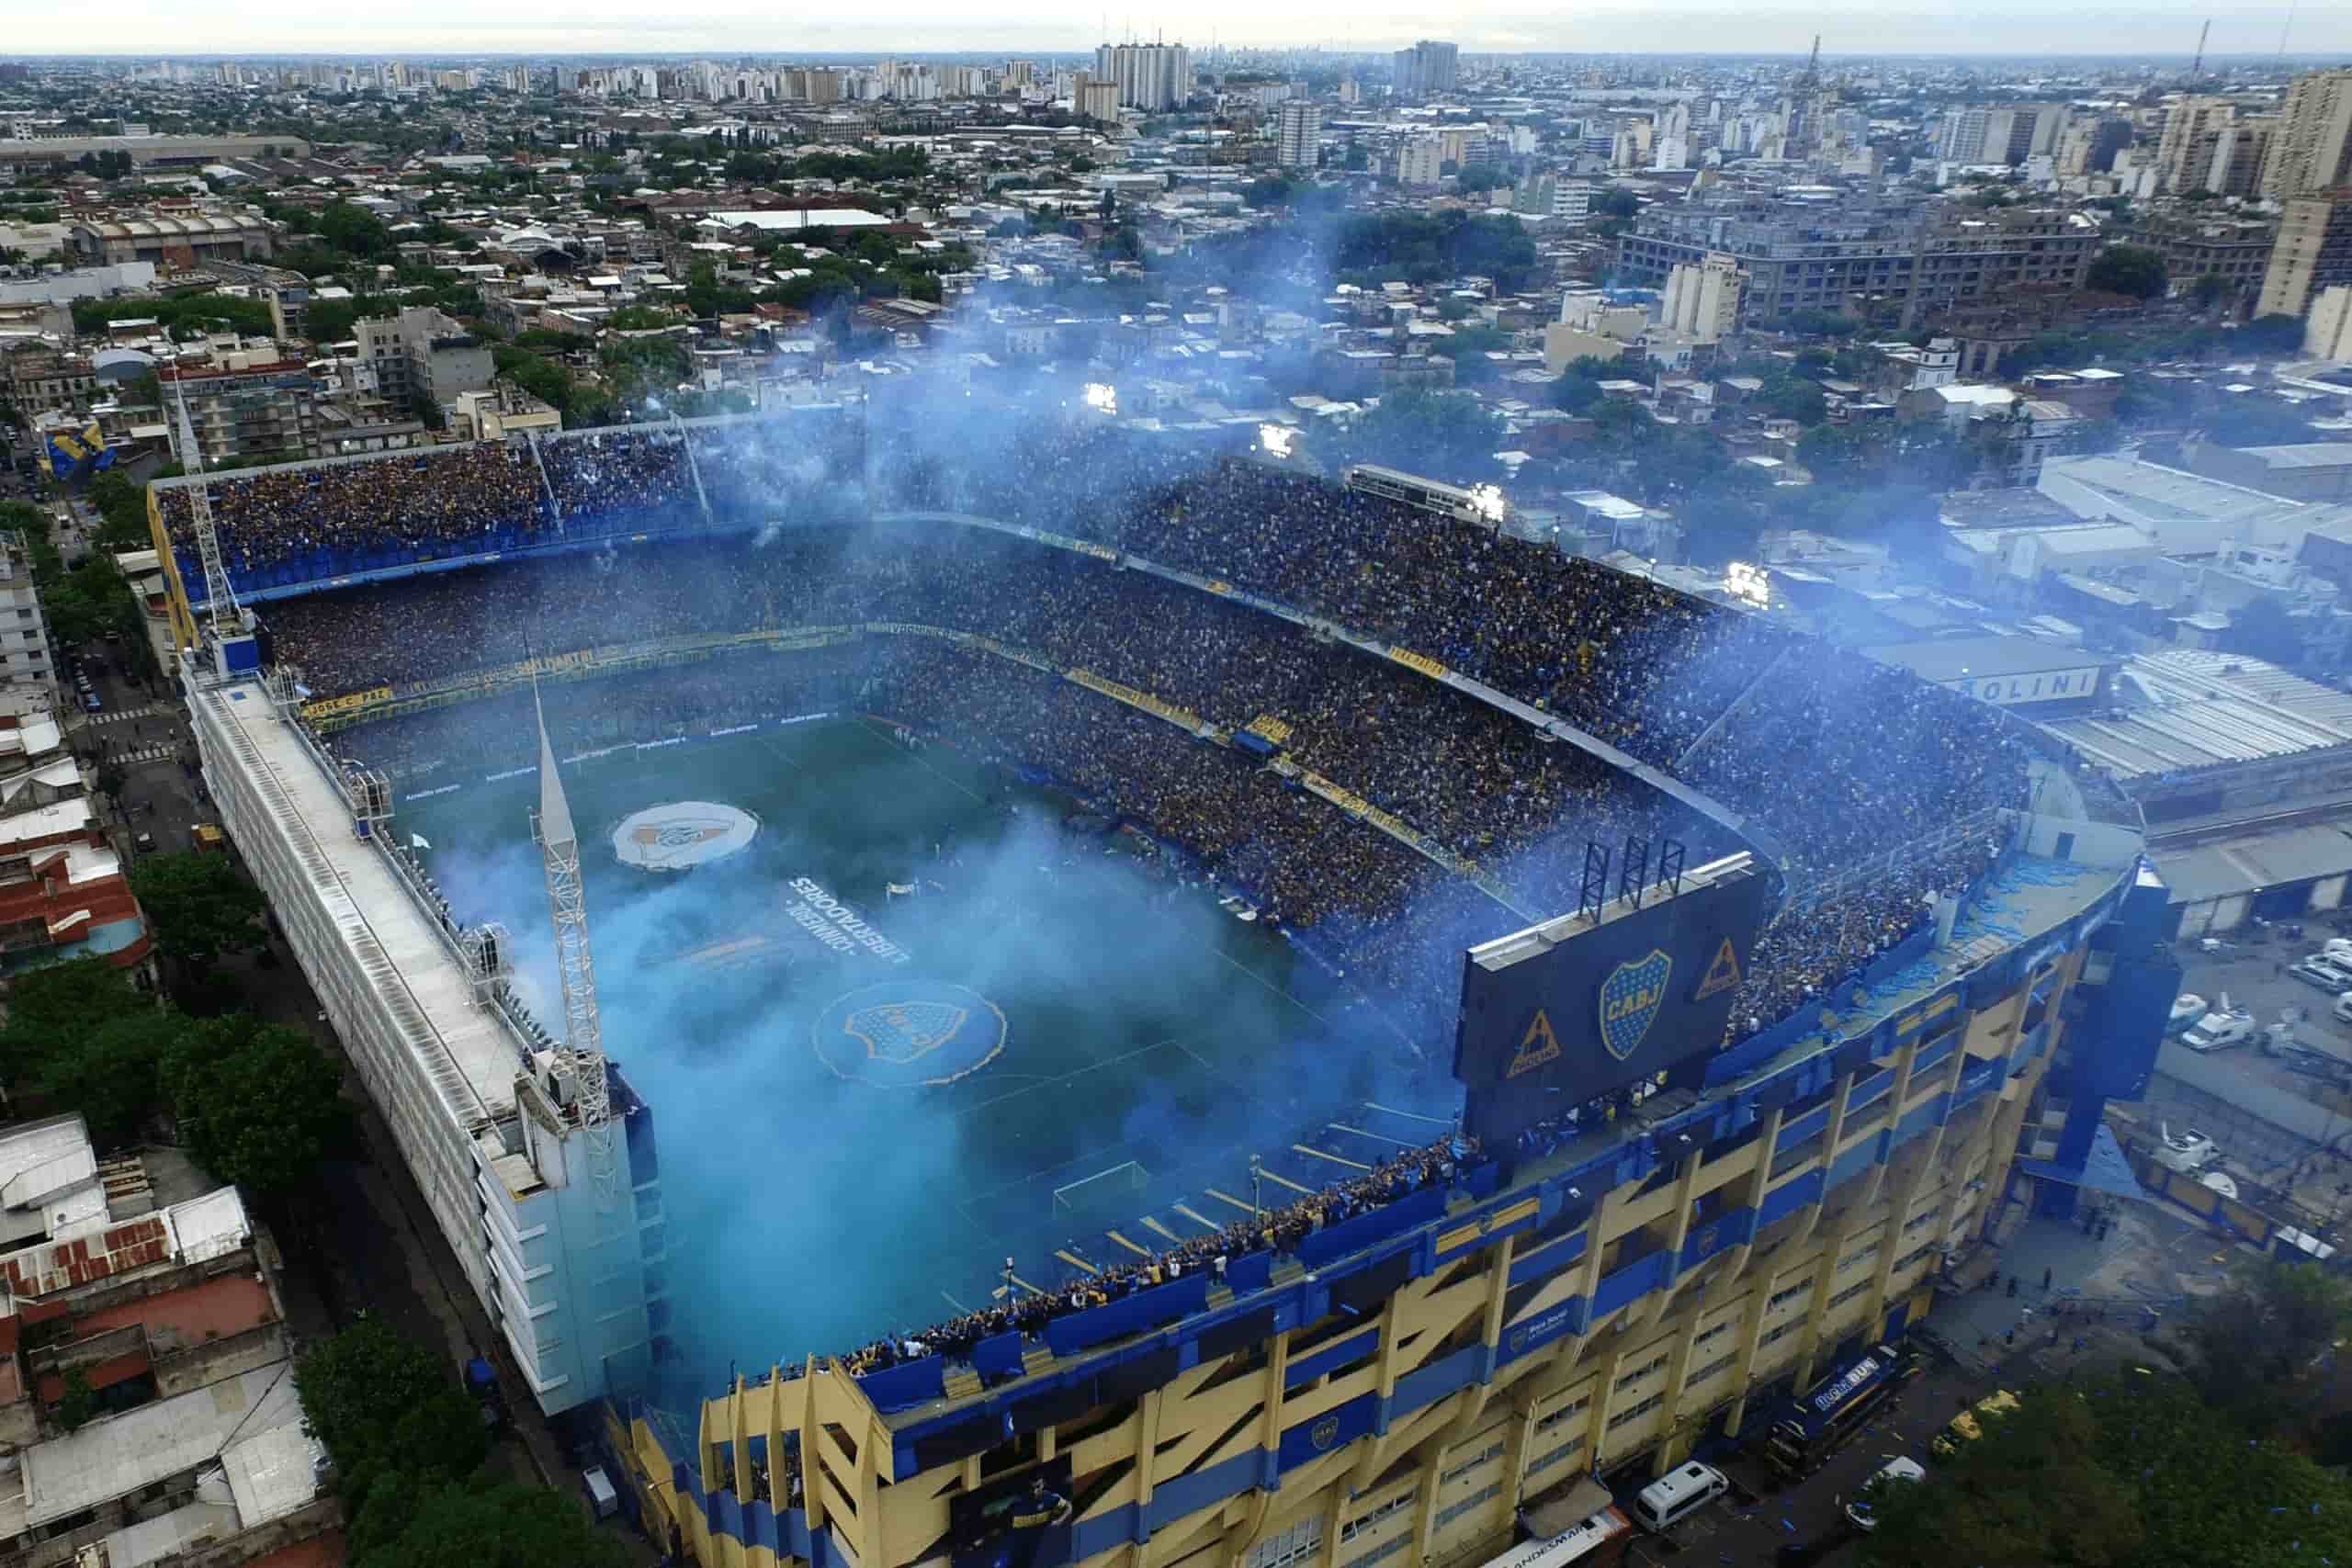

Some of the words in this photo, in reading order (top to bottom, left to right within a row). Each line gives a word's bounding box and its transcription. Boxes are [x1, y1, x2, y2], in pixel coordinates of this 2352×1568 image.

[1983, 673, 2089, 700] OLINI
[309, 701, 339, 715] JOSE
[345, 697, 354, 705] C
[788, 877, 911, 964] LIBERTADORES
[1608, 985, 1660, 1021] CABJ
